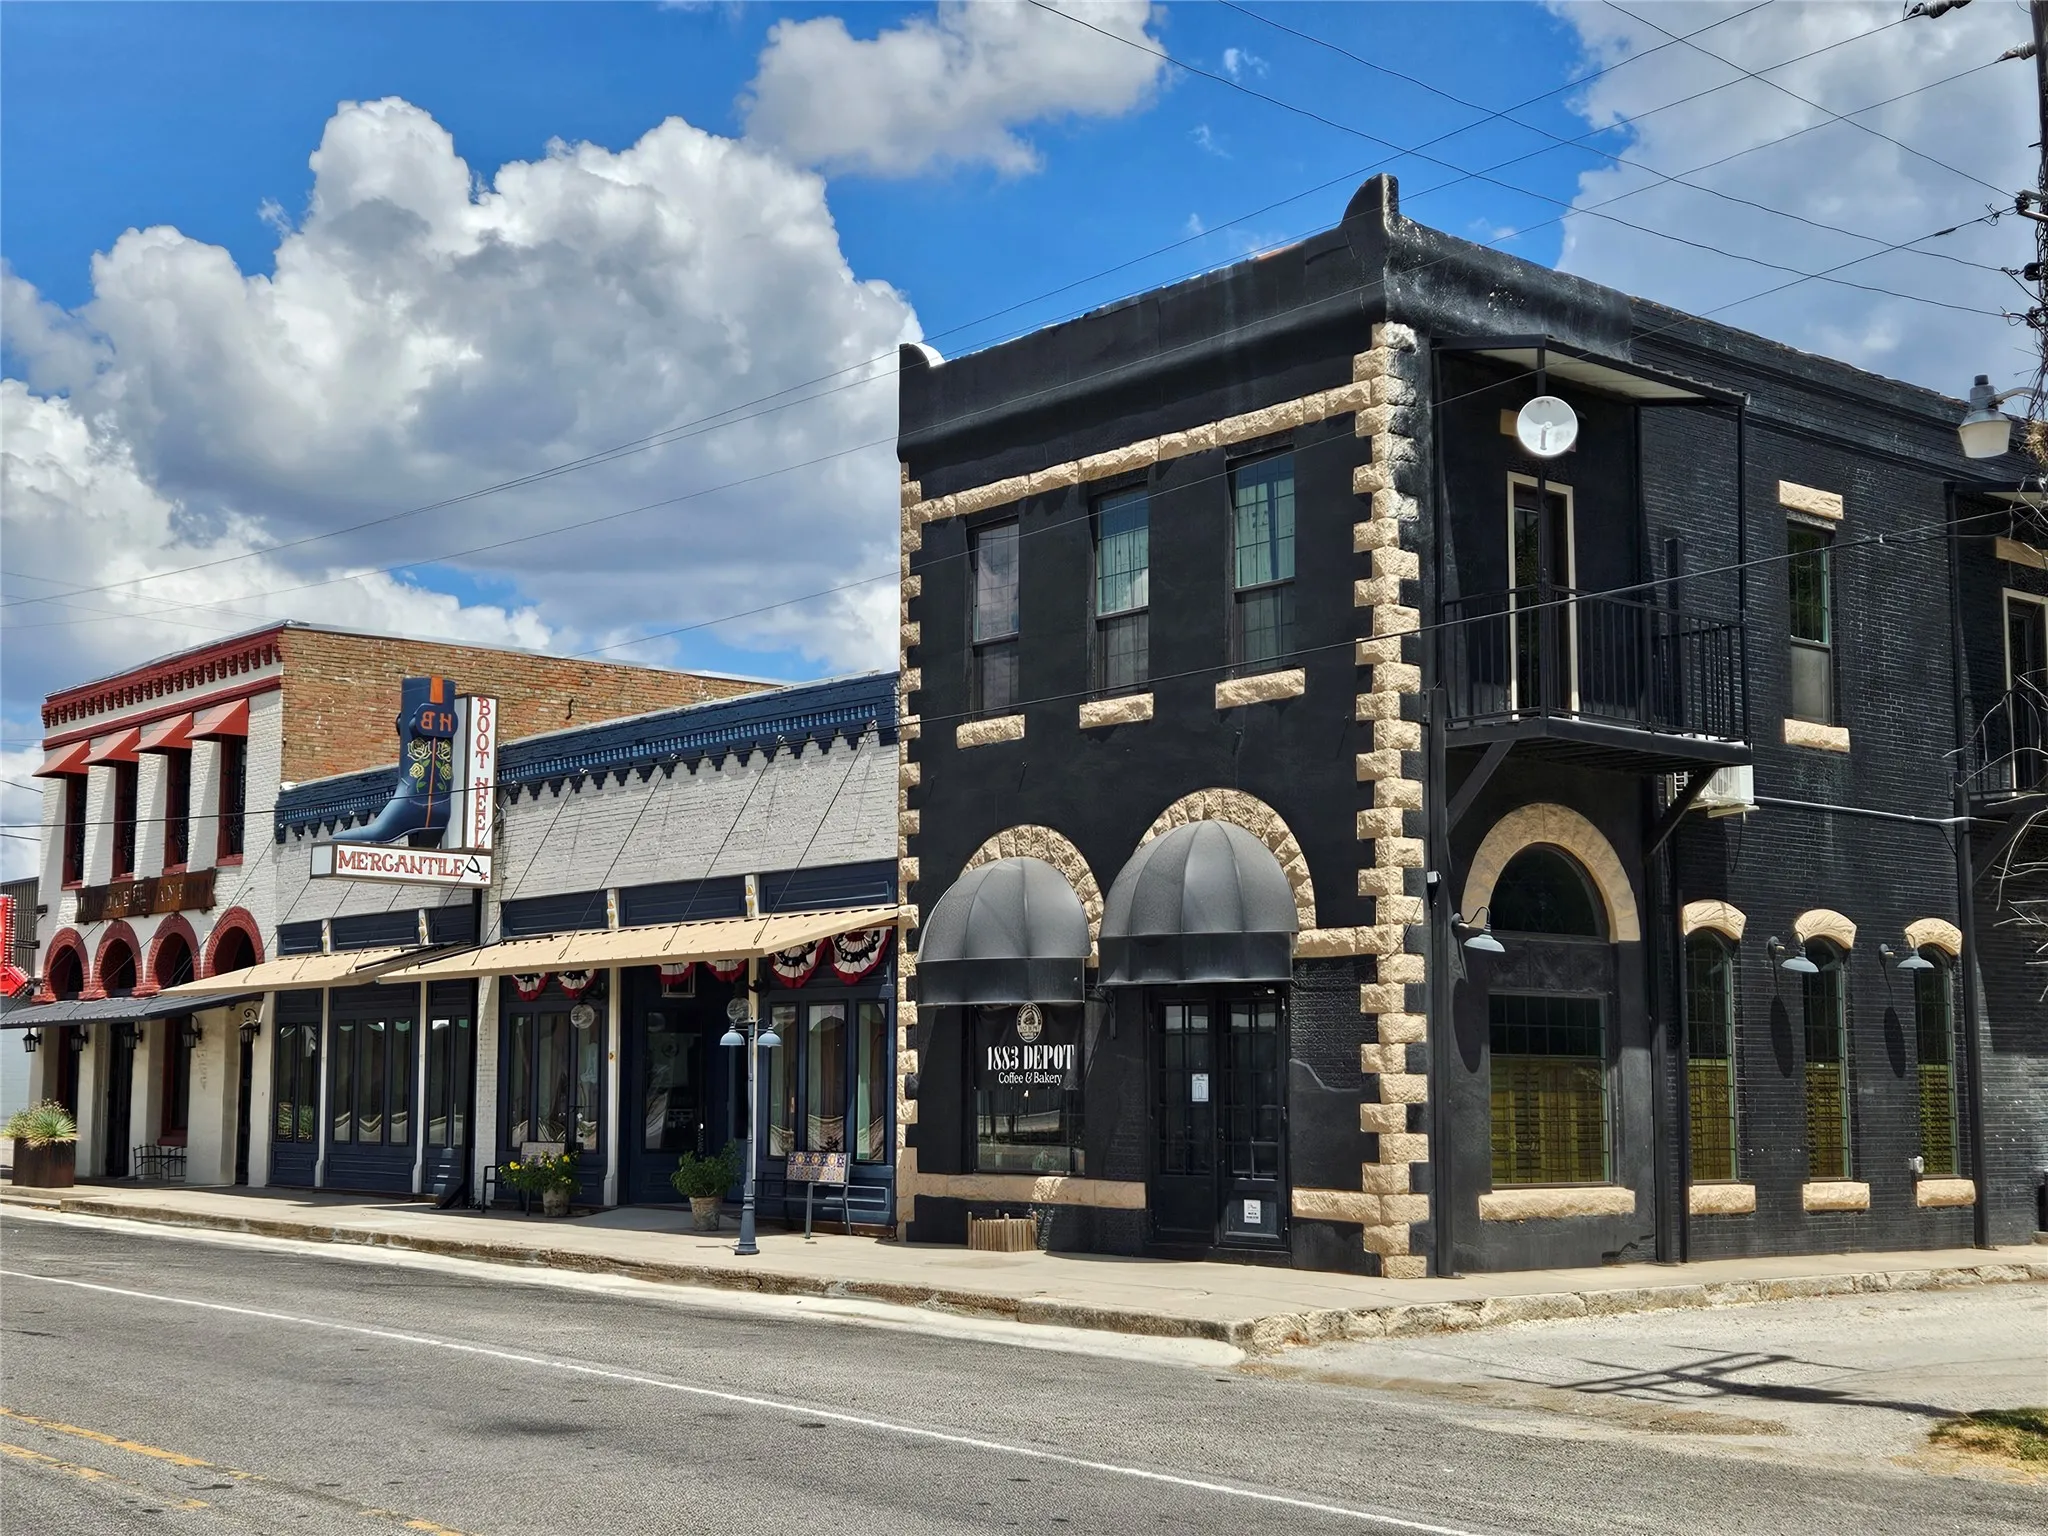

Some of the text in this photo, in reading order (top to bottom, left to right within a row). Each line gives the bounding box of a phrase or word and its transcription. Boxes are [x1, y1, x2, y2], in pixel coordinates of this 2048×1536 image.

[474, 697, 491, 848] BOOT HEEL
[338, 850, 465, 877] MERCANTILE
[987, 1044, 1075, 1071] 1883 DEPOT
[998, 1071, 1063, 1086] Coffee & Bakery
